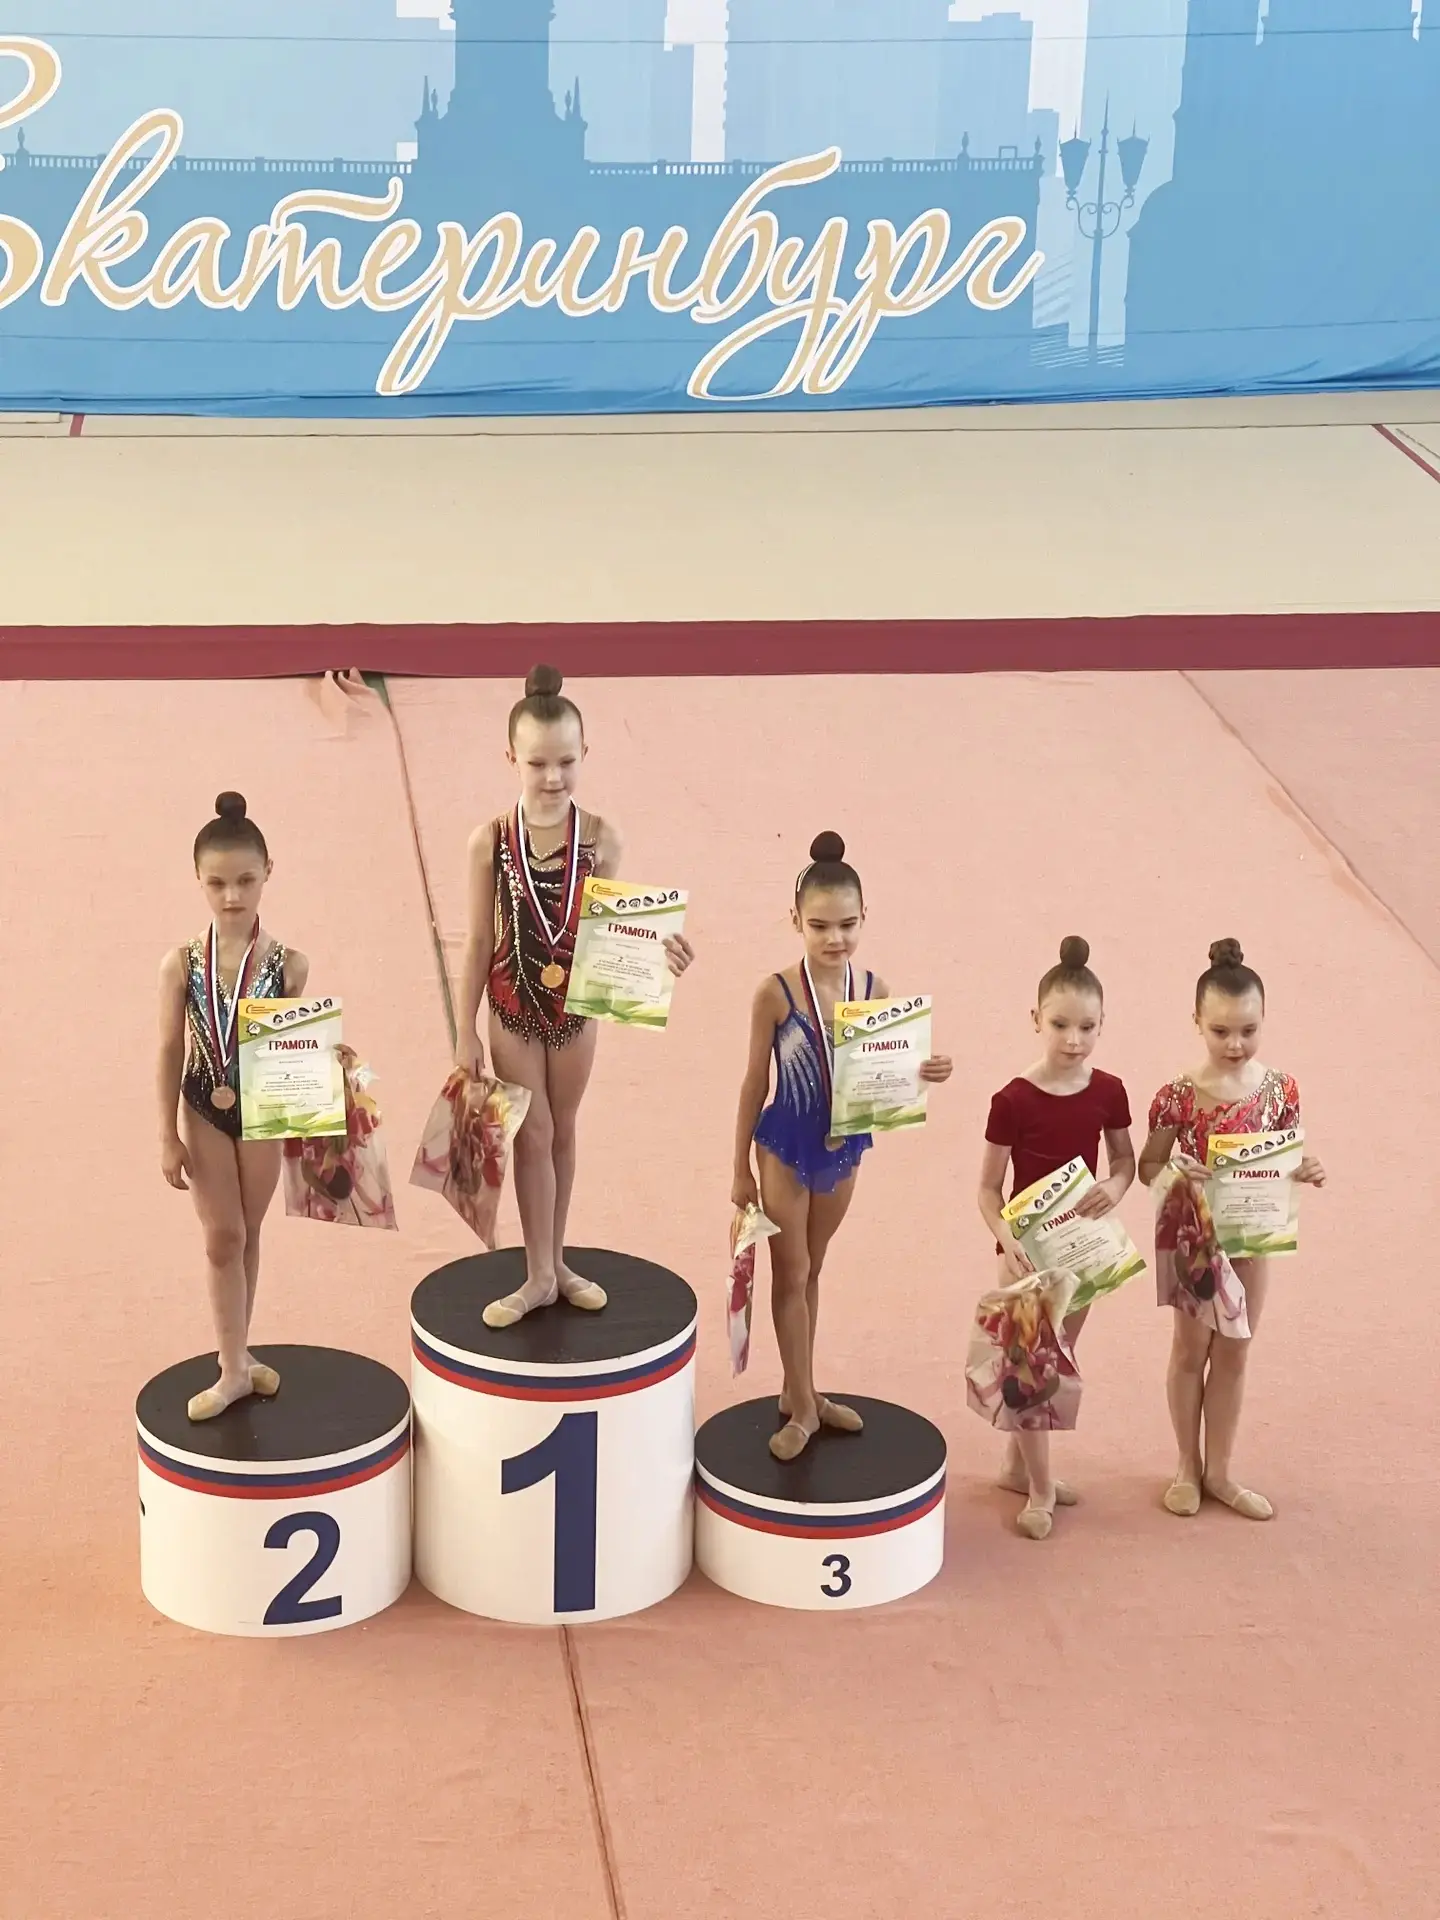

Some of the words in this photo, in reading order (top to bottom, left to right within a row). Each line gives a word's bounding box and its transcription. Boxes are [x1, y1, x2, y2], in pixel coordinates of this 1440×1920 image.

[607, 922, 658, 941] ГРАМОТА
[268, 1039, 319, 1051] ГРАМОТА
[862, 1039, 909, 1053] ГРАМОТА
[1232, 1169, 1281, 1179] ГРАМОТА
[1041, 1208, 1078, 1232] ГРАМО
[500, 1410, 599, 1613] 1
[262, 1511, 343, 1626] 2
[820, 1553, 852, 1598] 3
